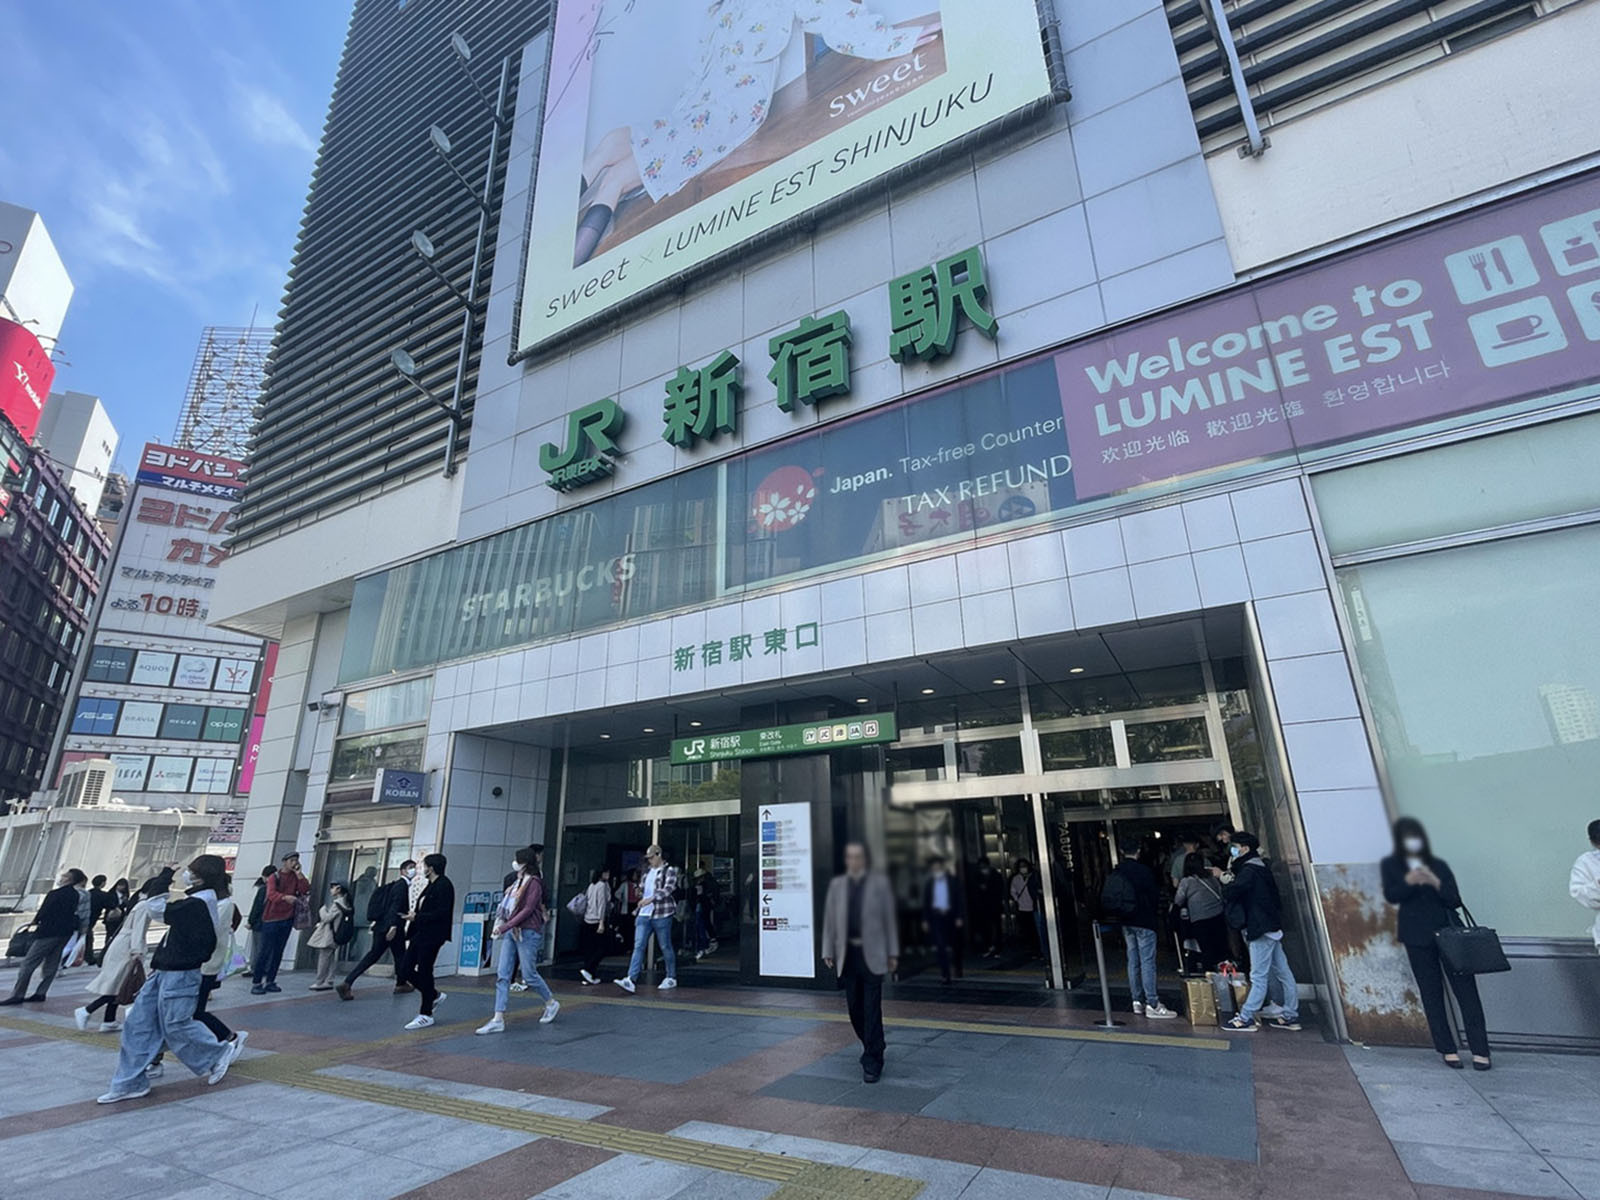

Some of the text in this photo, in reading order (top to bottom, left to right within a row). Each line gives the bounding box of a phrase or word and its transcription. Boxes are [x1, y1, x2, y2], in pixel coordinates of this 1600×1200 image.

[829, 53, 926, 118] sweet
[546, 257, 630, 319] sweet
[663, 190, 762, 258] LUMINE
[770, 160, 823, 206] EST
[830, 73, 994, 174] SHINJUKU
[539, 246, 1000, 474] JR 新宿駅
[1085, 278, 1423, 394] Welcome to
[1093, 311, 1434, 437] LUMINE EST
[1101, 360, 1452, 464] 欢迎光临 歡迎光臨 환영합니다
[830, 415, 1064, 494] Japan. Tax-free Counter
[902, 484, 952, 515] TAX
[958, 455, 1072, 501] REFUND
[462, 553, 636, 621] STARBUCKS
[674, 622, 818, 672] 新宿駅東口
[683, 735, 740, 755] JR 新宿駅
[385, 789, 419, 798] KOBAN
